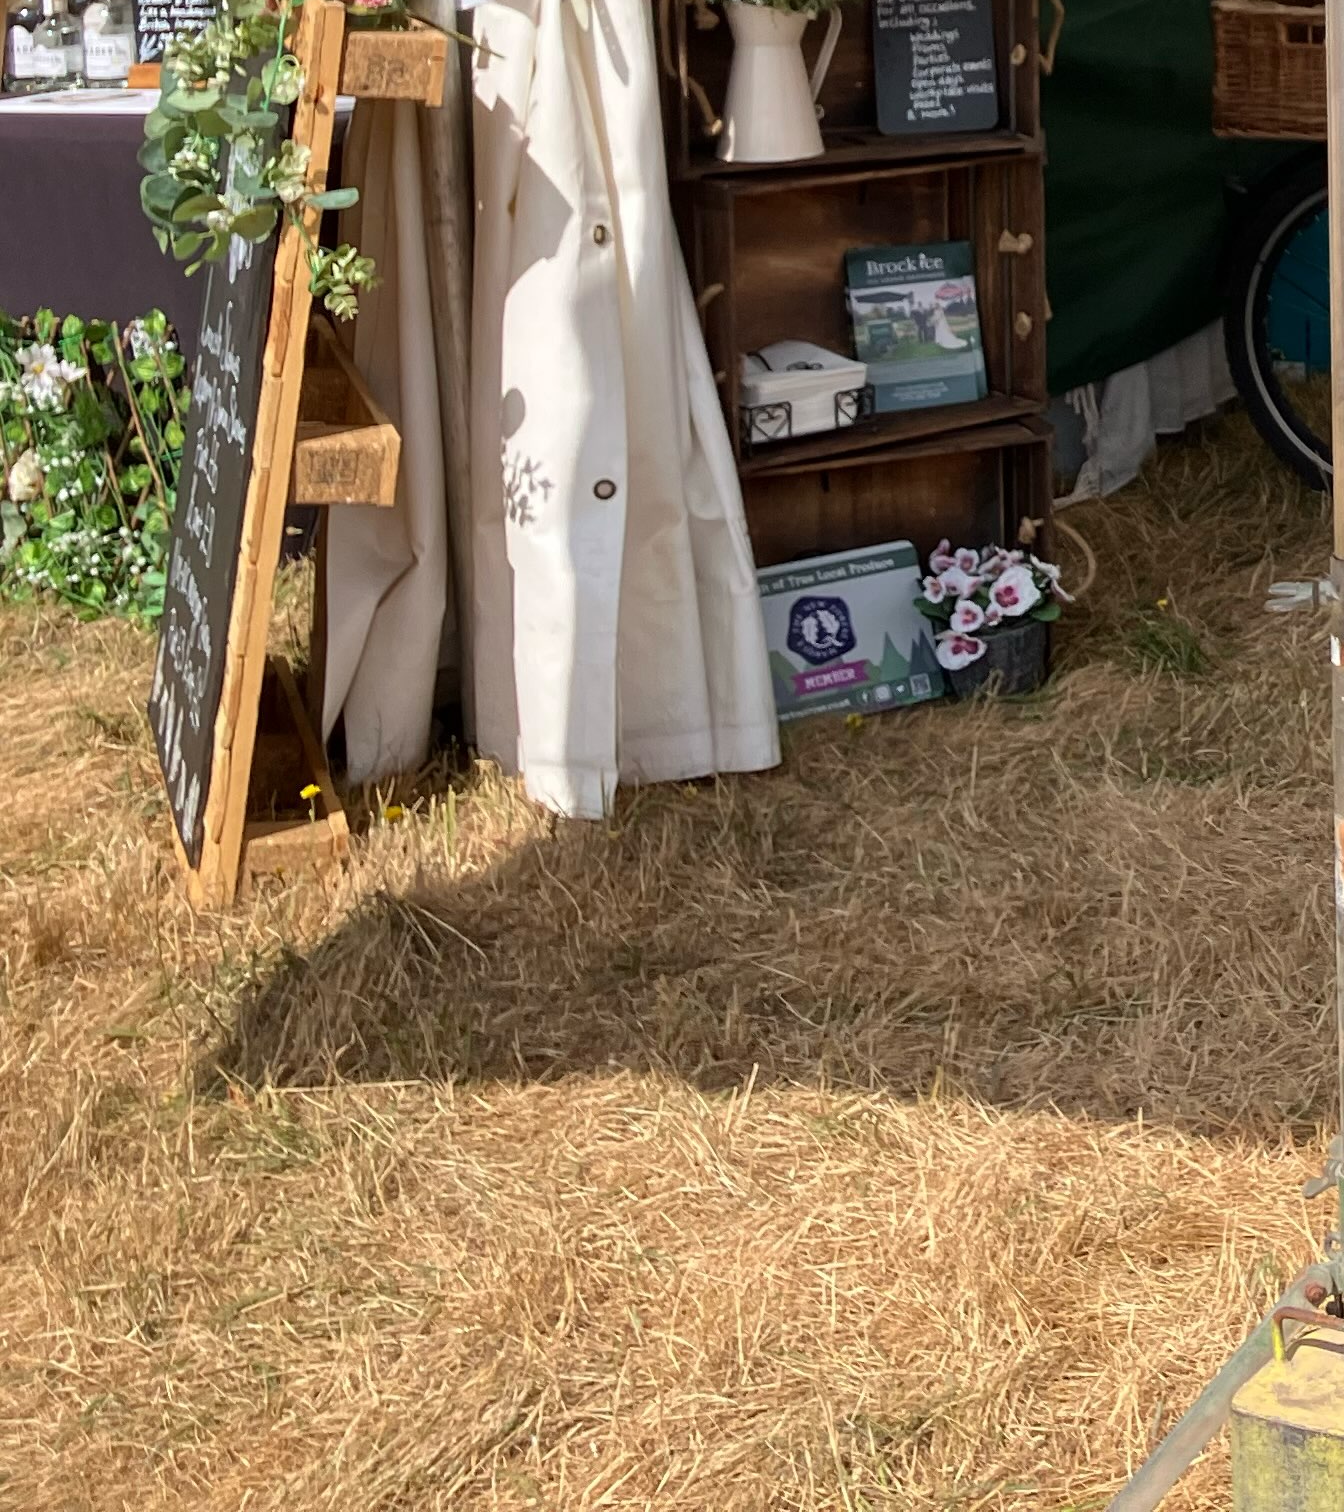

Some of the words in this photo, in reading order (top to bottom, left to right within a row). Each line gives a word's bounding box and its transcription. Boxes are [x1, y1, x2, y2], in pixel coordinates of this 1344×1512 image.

[866, 255, 917, 277] Brock
[816, 566, 847, 581] Local
[847, 558, 895, 575] Produce
[804, 668, 858, 691] MEMBER
